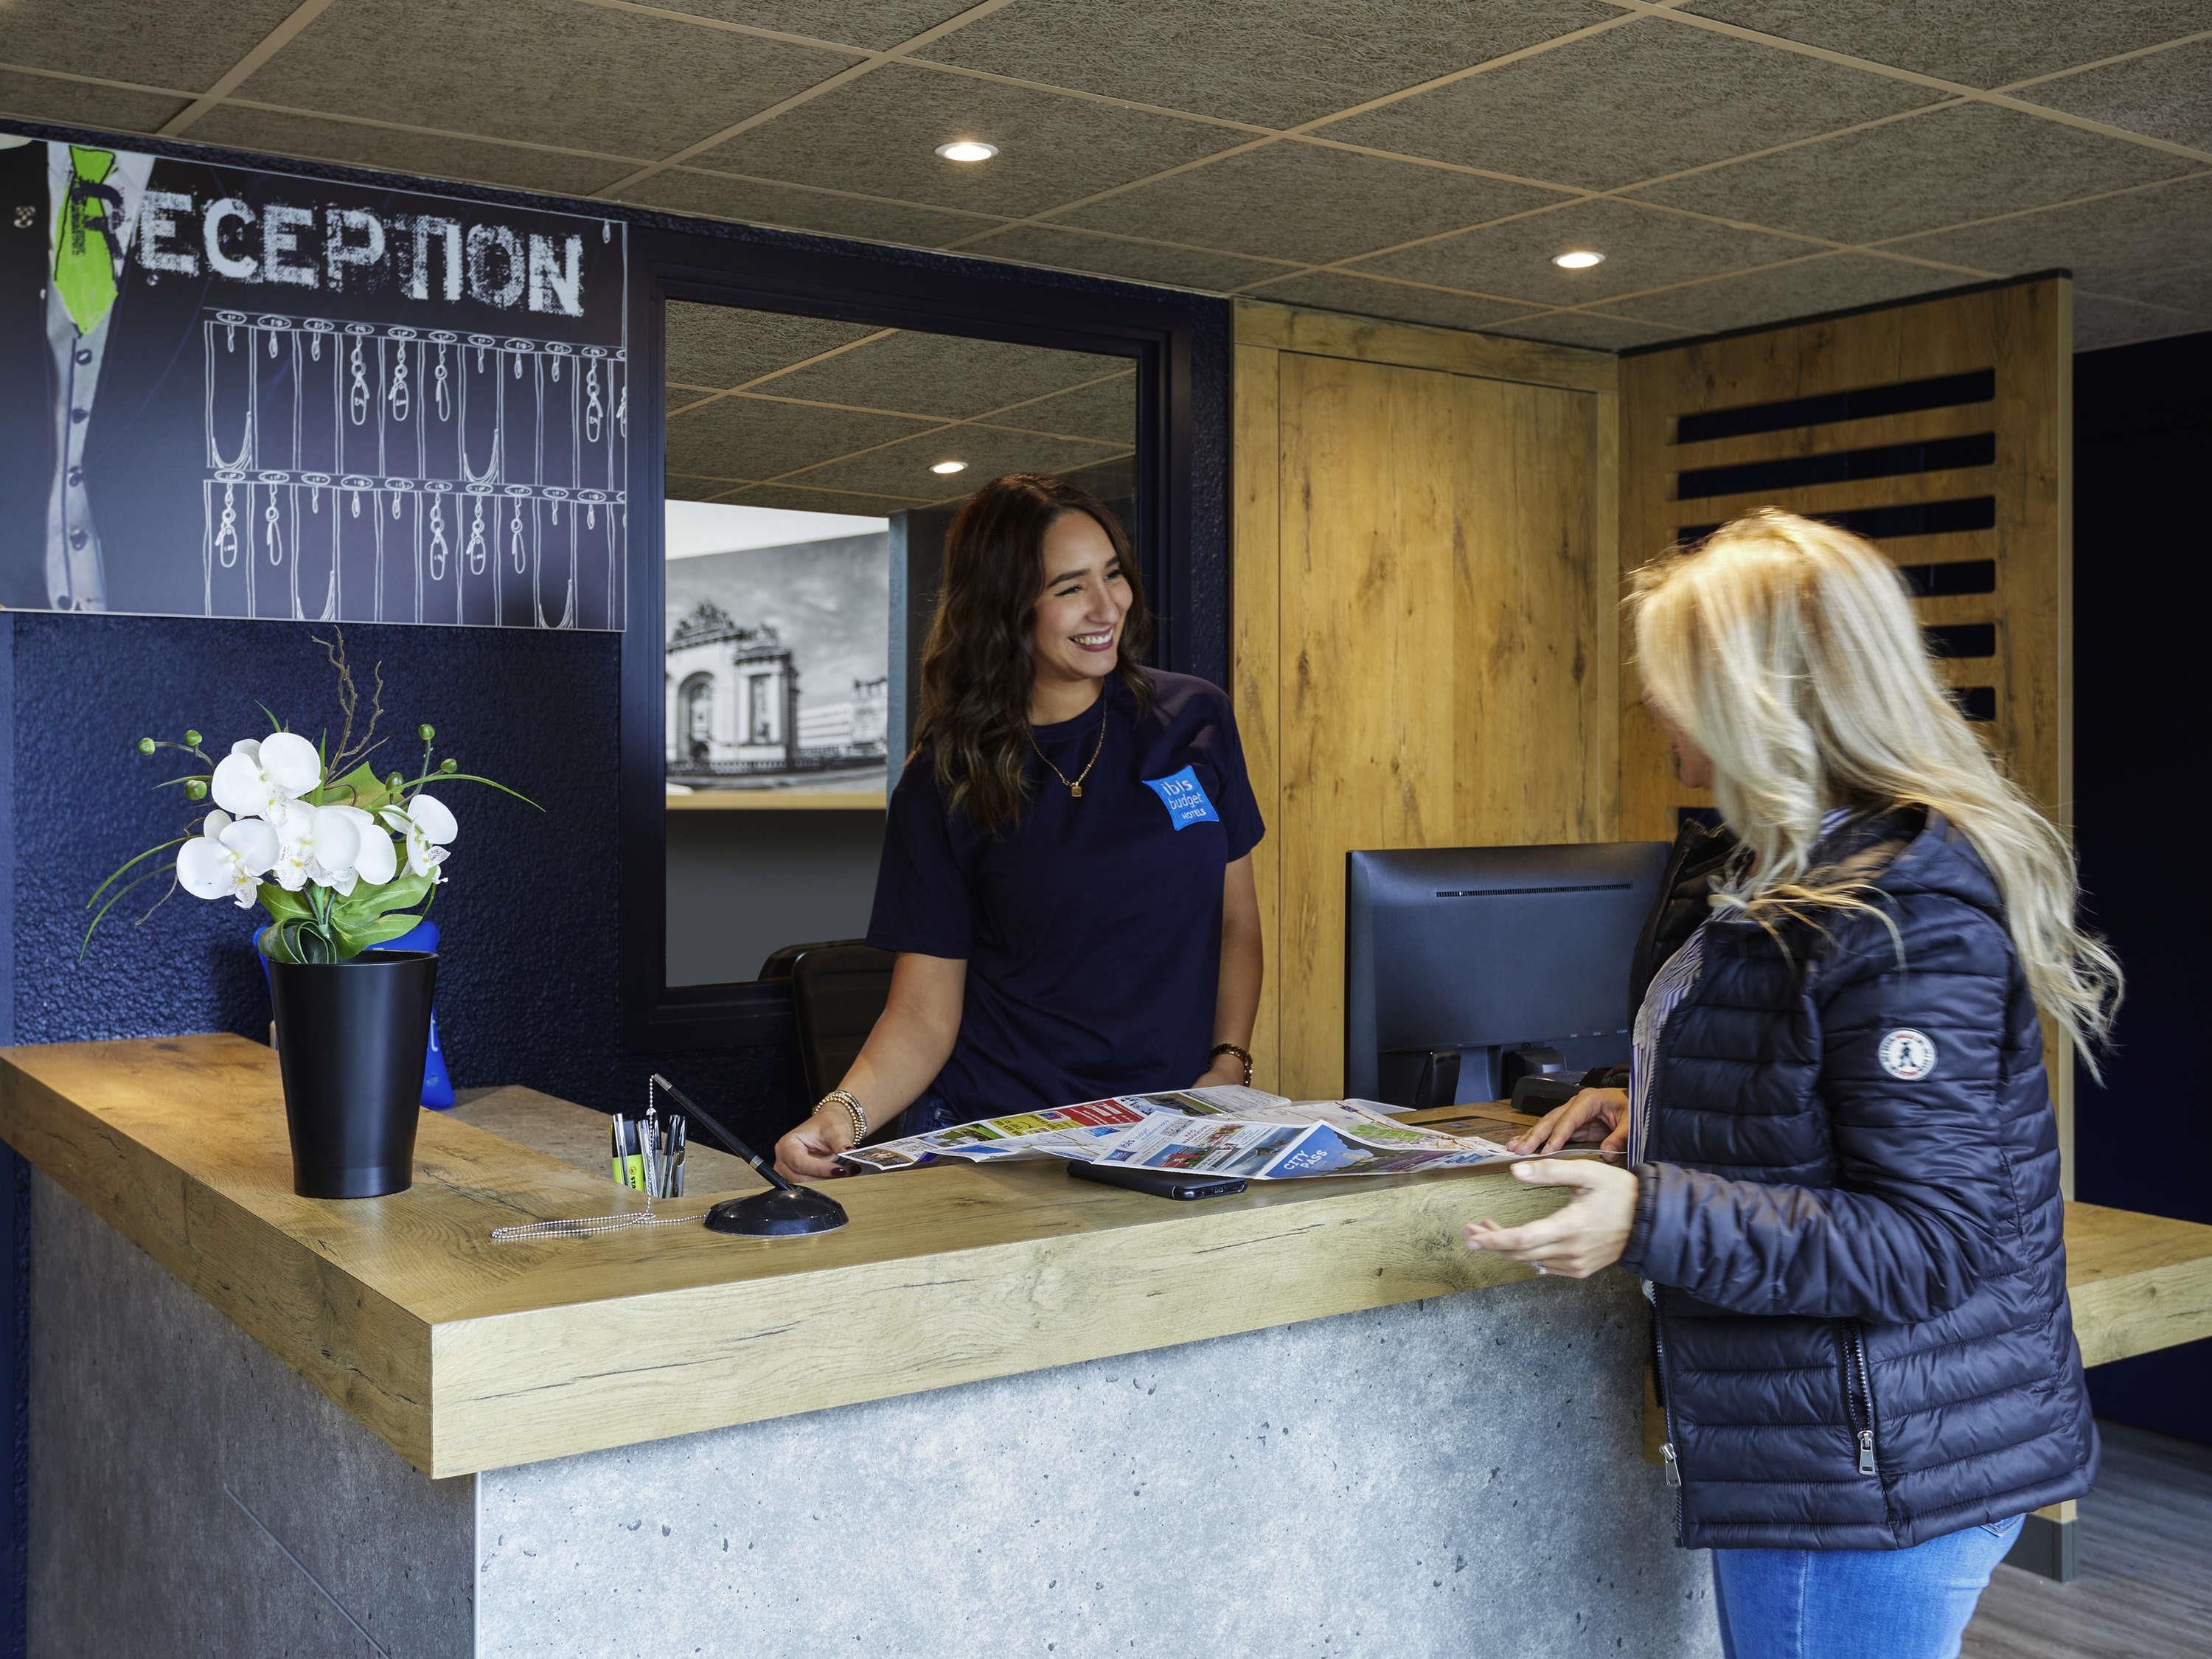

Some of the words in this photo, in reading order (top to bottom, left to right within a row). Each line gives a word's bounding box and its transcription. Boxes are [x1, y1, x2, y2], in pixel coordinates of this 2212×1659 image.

[69, 175, 585, 317] RECEPTION
[1161, 779, 1193, 796] ibis
[1169, 792, 1203, 810] budget
[1182, 809, 1206, 820] HOTELS
[1283, 1150, 1309, 1170] CITY
[1300, 1150, 1328, 1169] PASS
